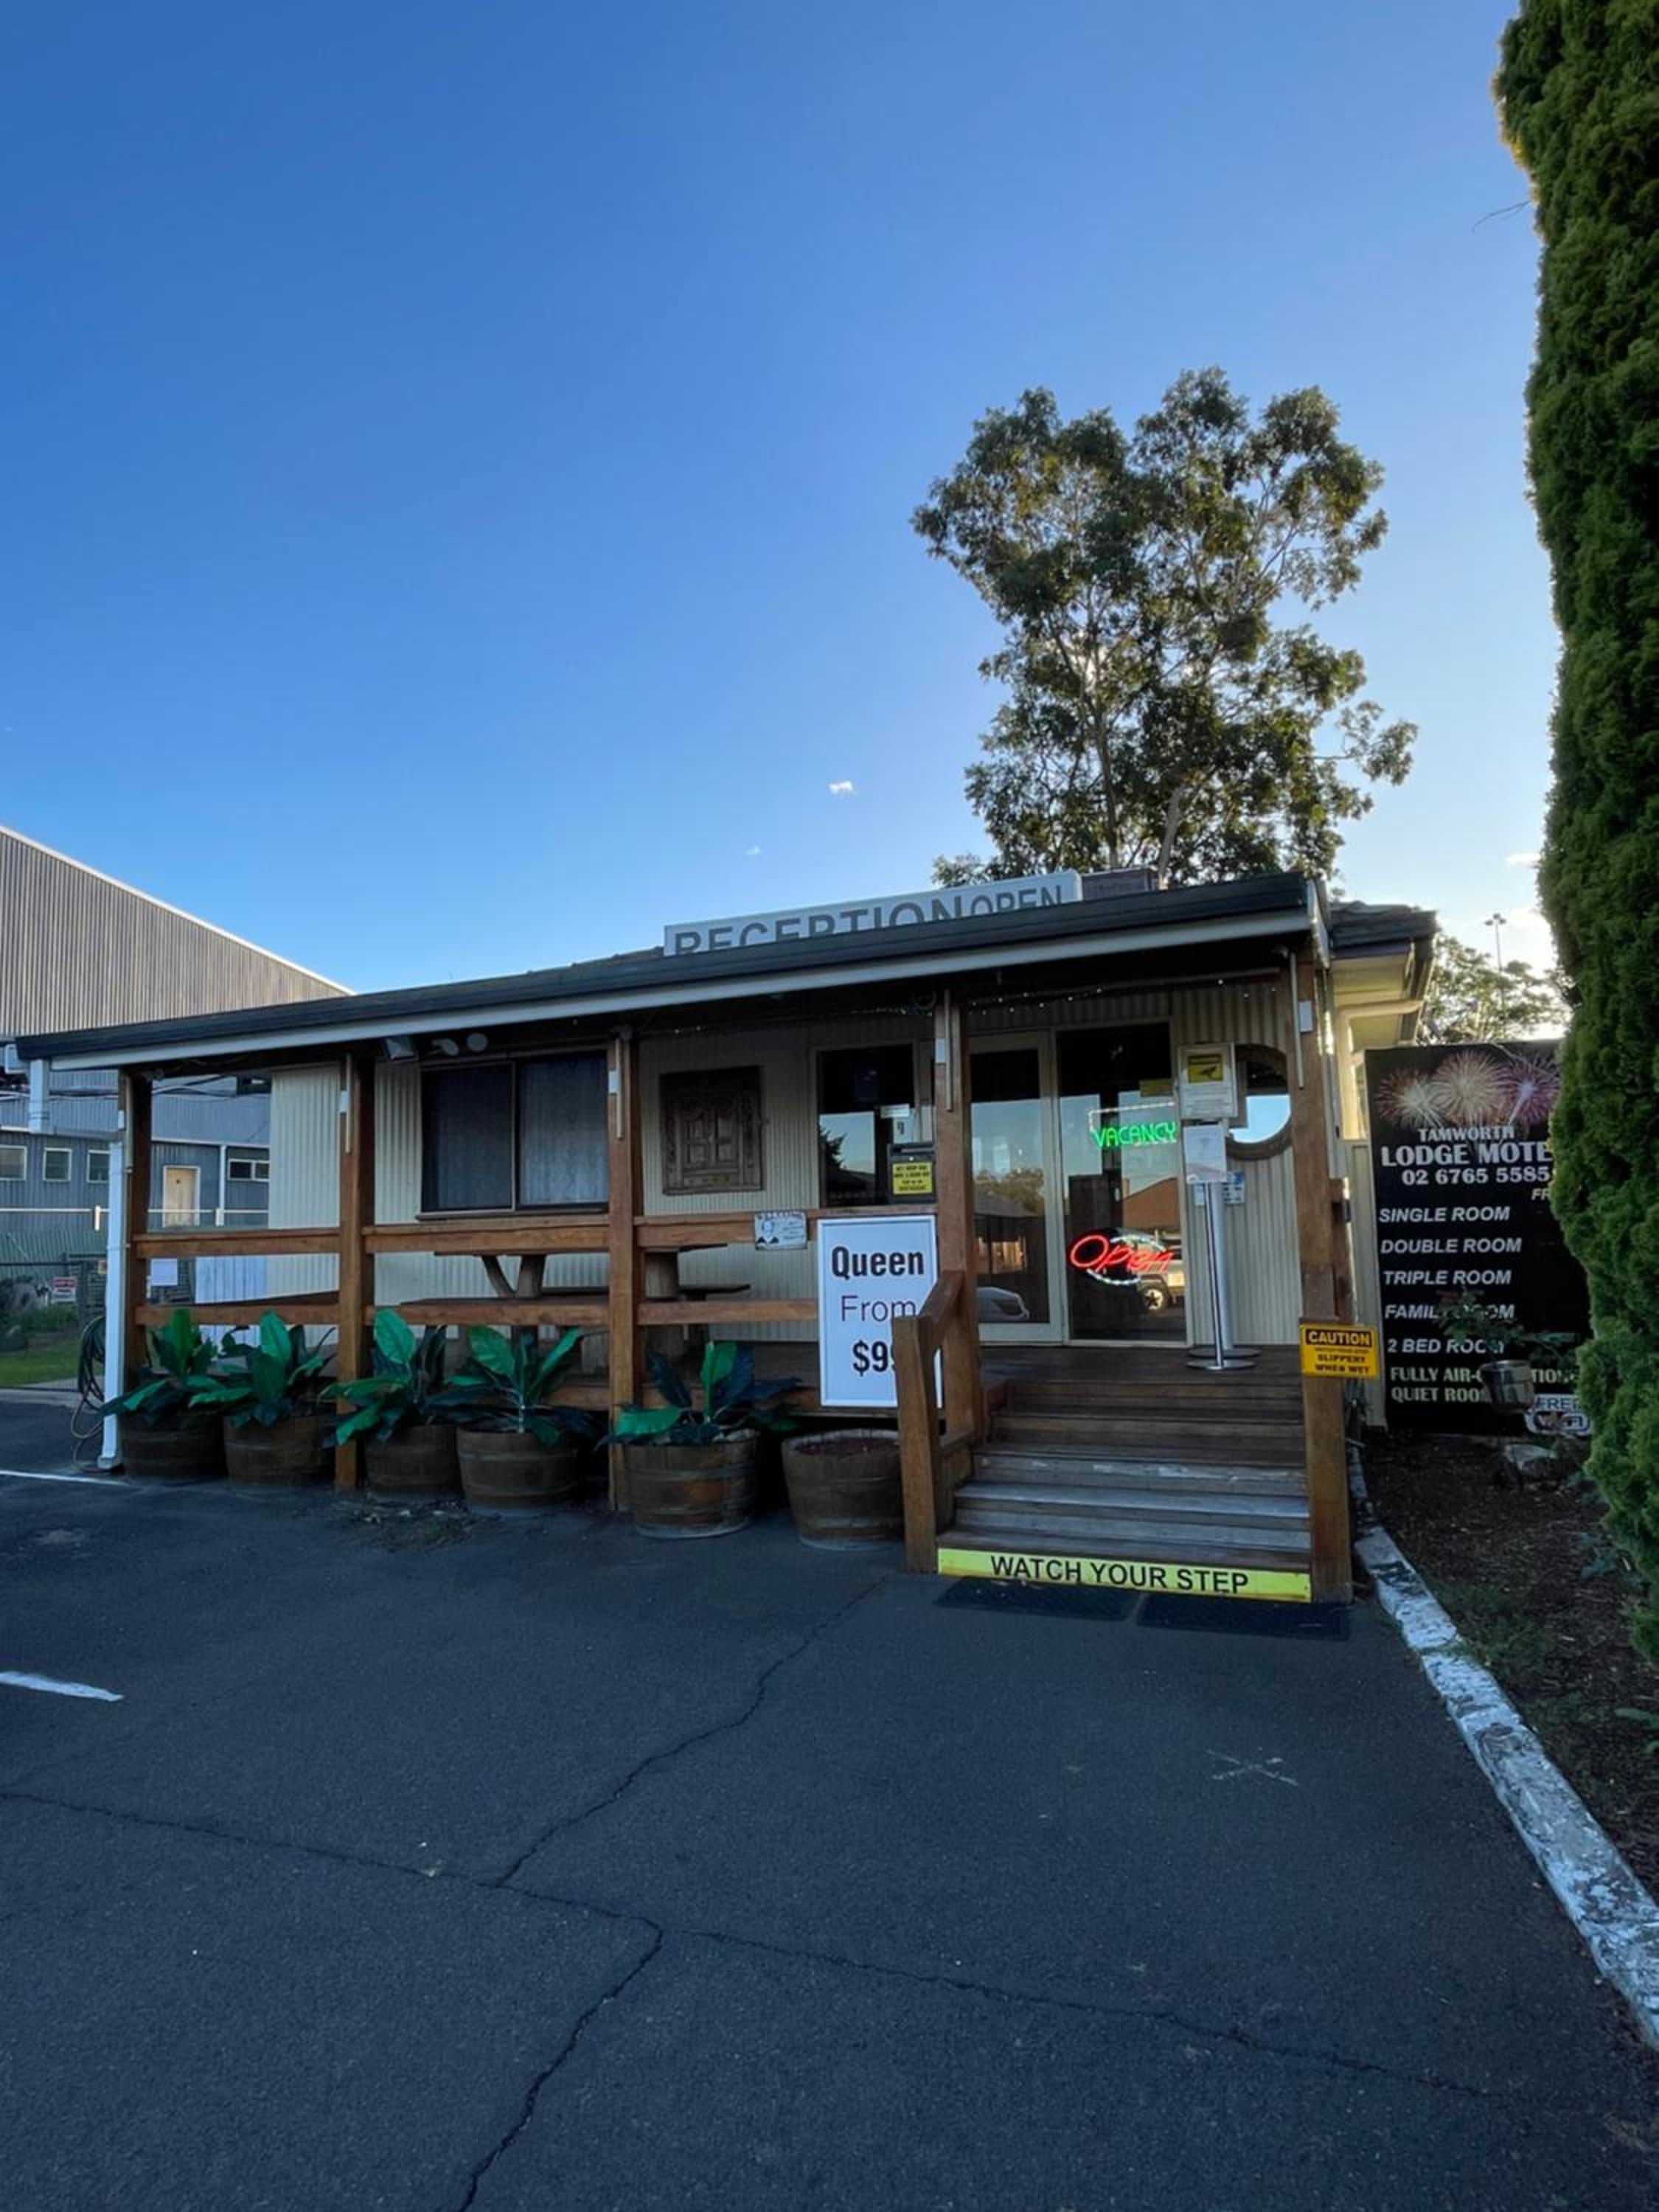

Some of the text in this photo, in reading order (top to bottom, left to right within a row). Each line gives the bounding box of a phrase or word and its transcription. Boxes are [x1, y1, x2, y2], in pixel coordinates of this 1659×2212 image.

[674, 885, 1062, 956] RECEPTION OPEN
[1091, 1121, 1177, 1147] VACANCY
[1418, 1125, 1514, 1143] TAMWORTH
[1381, 1141, 1554, 1167] LODGE MOTE
[1402, 1166, 1550, 1186] 02 6765 5585
[1379, 1206, 1510, 1223] SINGLE ROOM
[1071, 1235, 1173, 1273] Open
[1380, 1238, 1522, 1253] DOUBLE ROOM
[832, 1245, 924, 1281] Queen
[1383, 1270, 1512, 1285] TRIPLE ROOM
[841, 1295, 917, 1322] From
[1384, 1304, 1447, 1319] FAMIL
[1309, 1331, 1370, 1346] CAUTION
[1387, 1338, 1398, 1354] 2
[1402, 1338, 1441, 1354] BED
[852, 1340, 895, 1377] $9
[1391, 1367, 1439, 1382] FULLY
[1391, 1387, 1439, 1403] QUIET
[990, 1555, 1248, 1595] WATCH YOUR STEP
